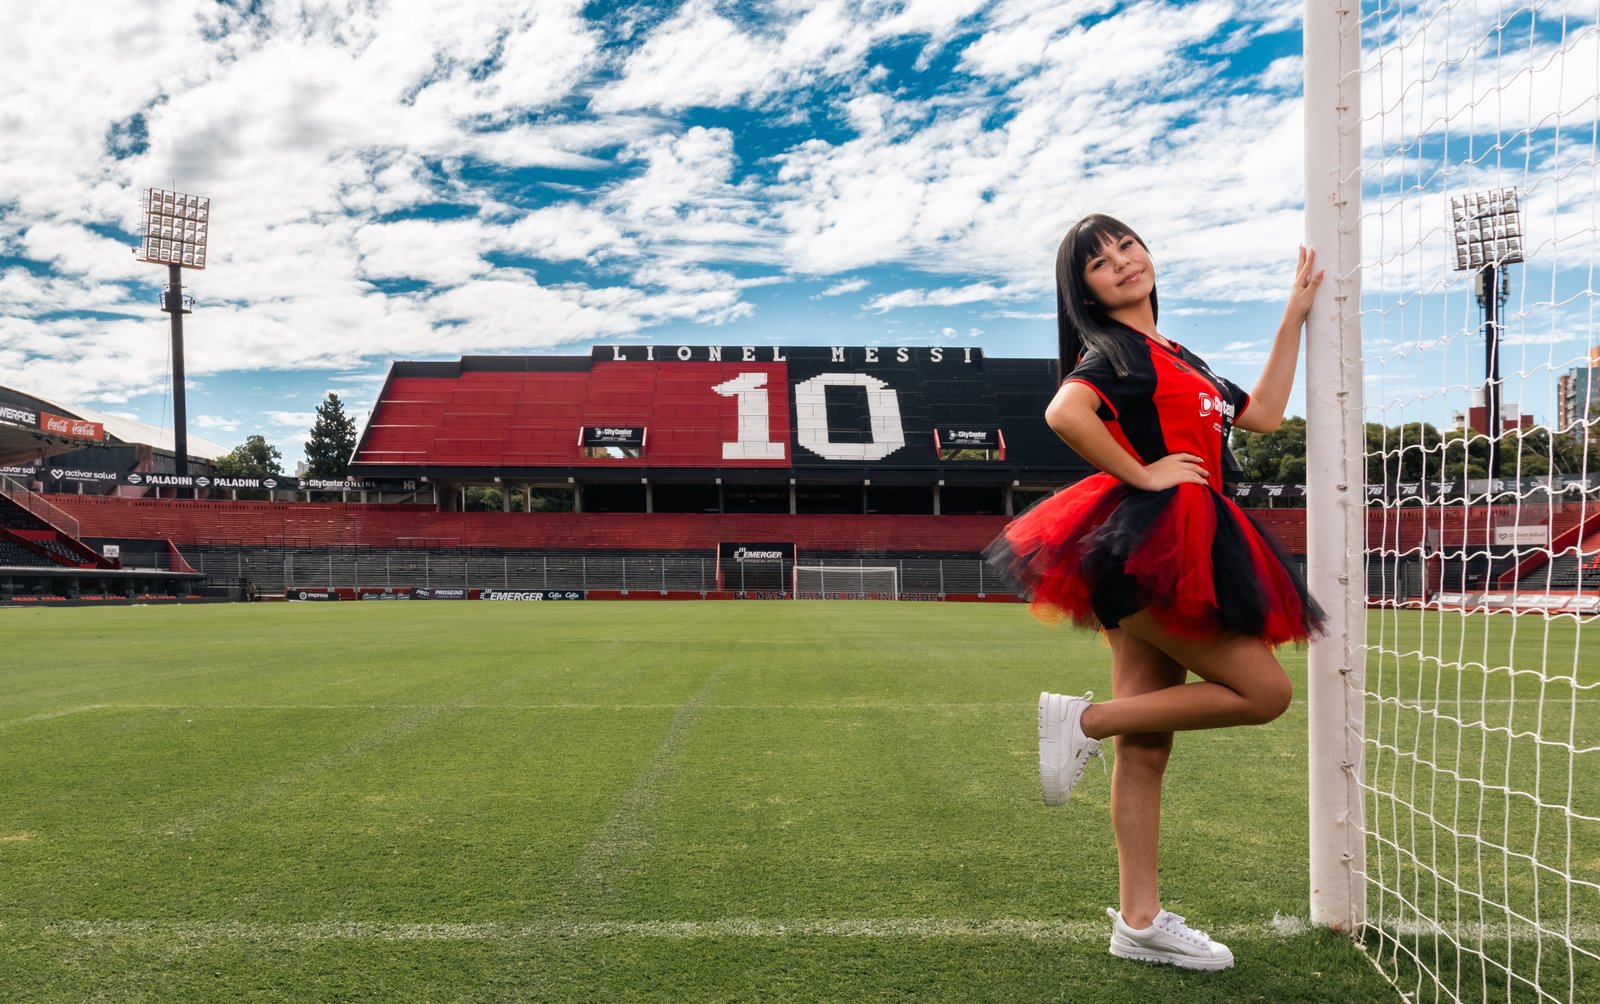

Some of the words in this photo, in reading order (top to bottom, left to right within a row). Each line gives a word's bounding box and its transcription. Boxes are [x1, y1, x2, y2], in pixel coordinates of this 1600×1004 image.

[612, 346, 787, 362] LIONEL
[831, 346, 972, 363] MESSI
[711, 372, 905, 460] 10
[65, 469, 93, 478] activar
[93, 471, 117, 480] salud
[146, 475, 193, 486] PALADINI
[214, 478, 260, 488] PALADINI
[1236, 488, 1251, 496] 78
[1268, 488, 1283, 496] 78
[1368, 486, 1383, 495] 78
[1402, 486, 1417, 494] 78
[743, 551, 783, 559] EMERGER
[489, 592, 544, 601] EMERGER
